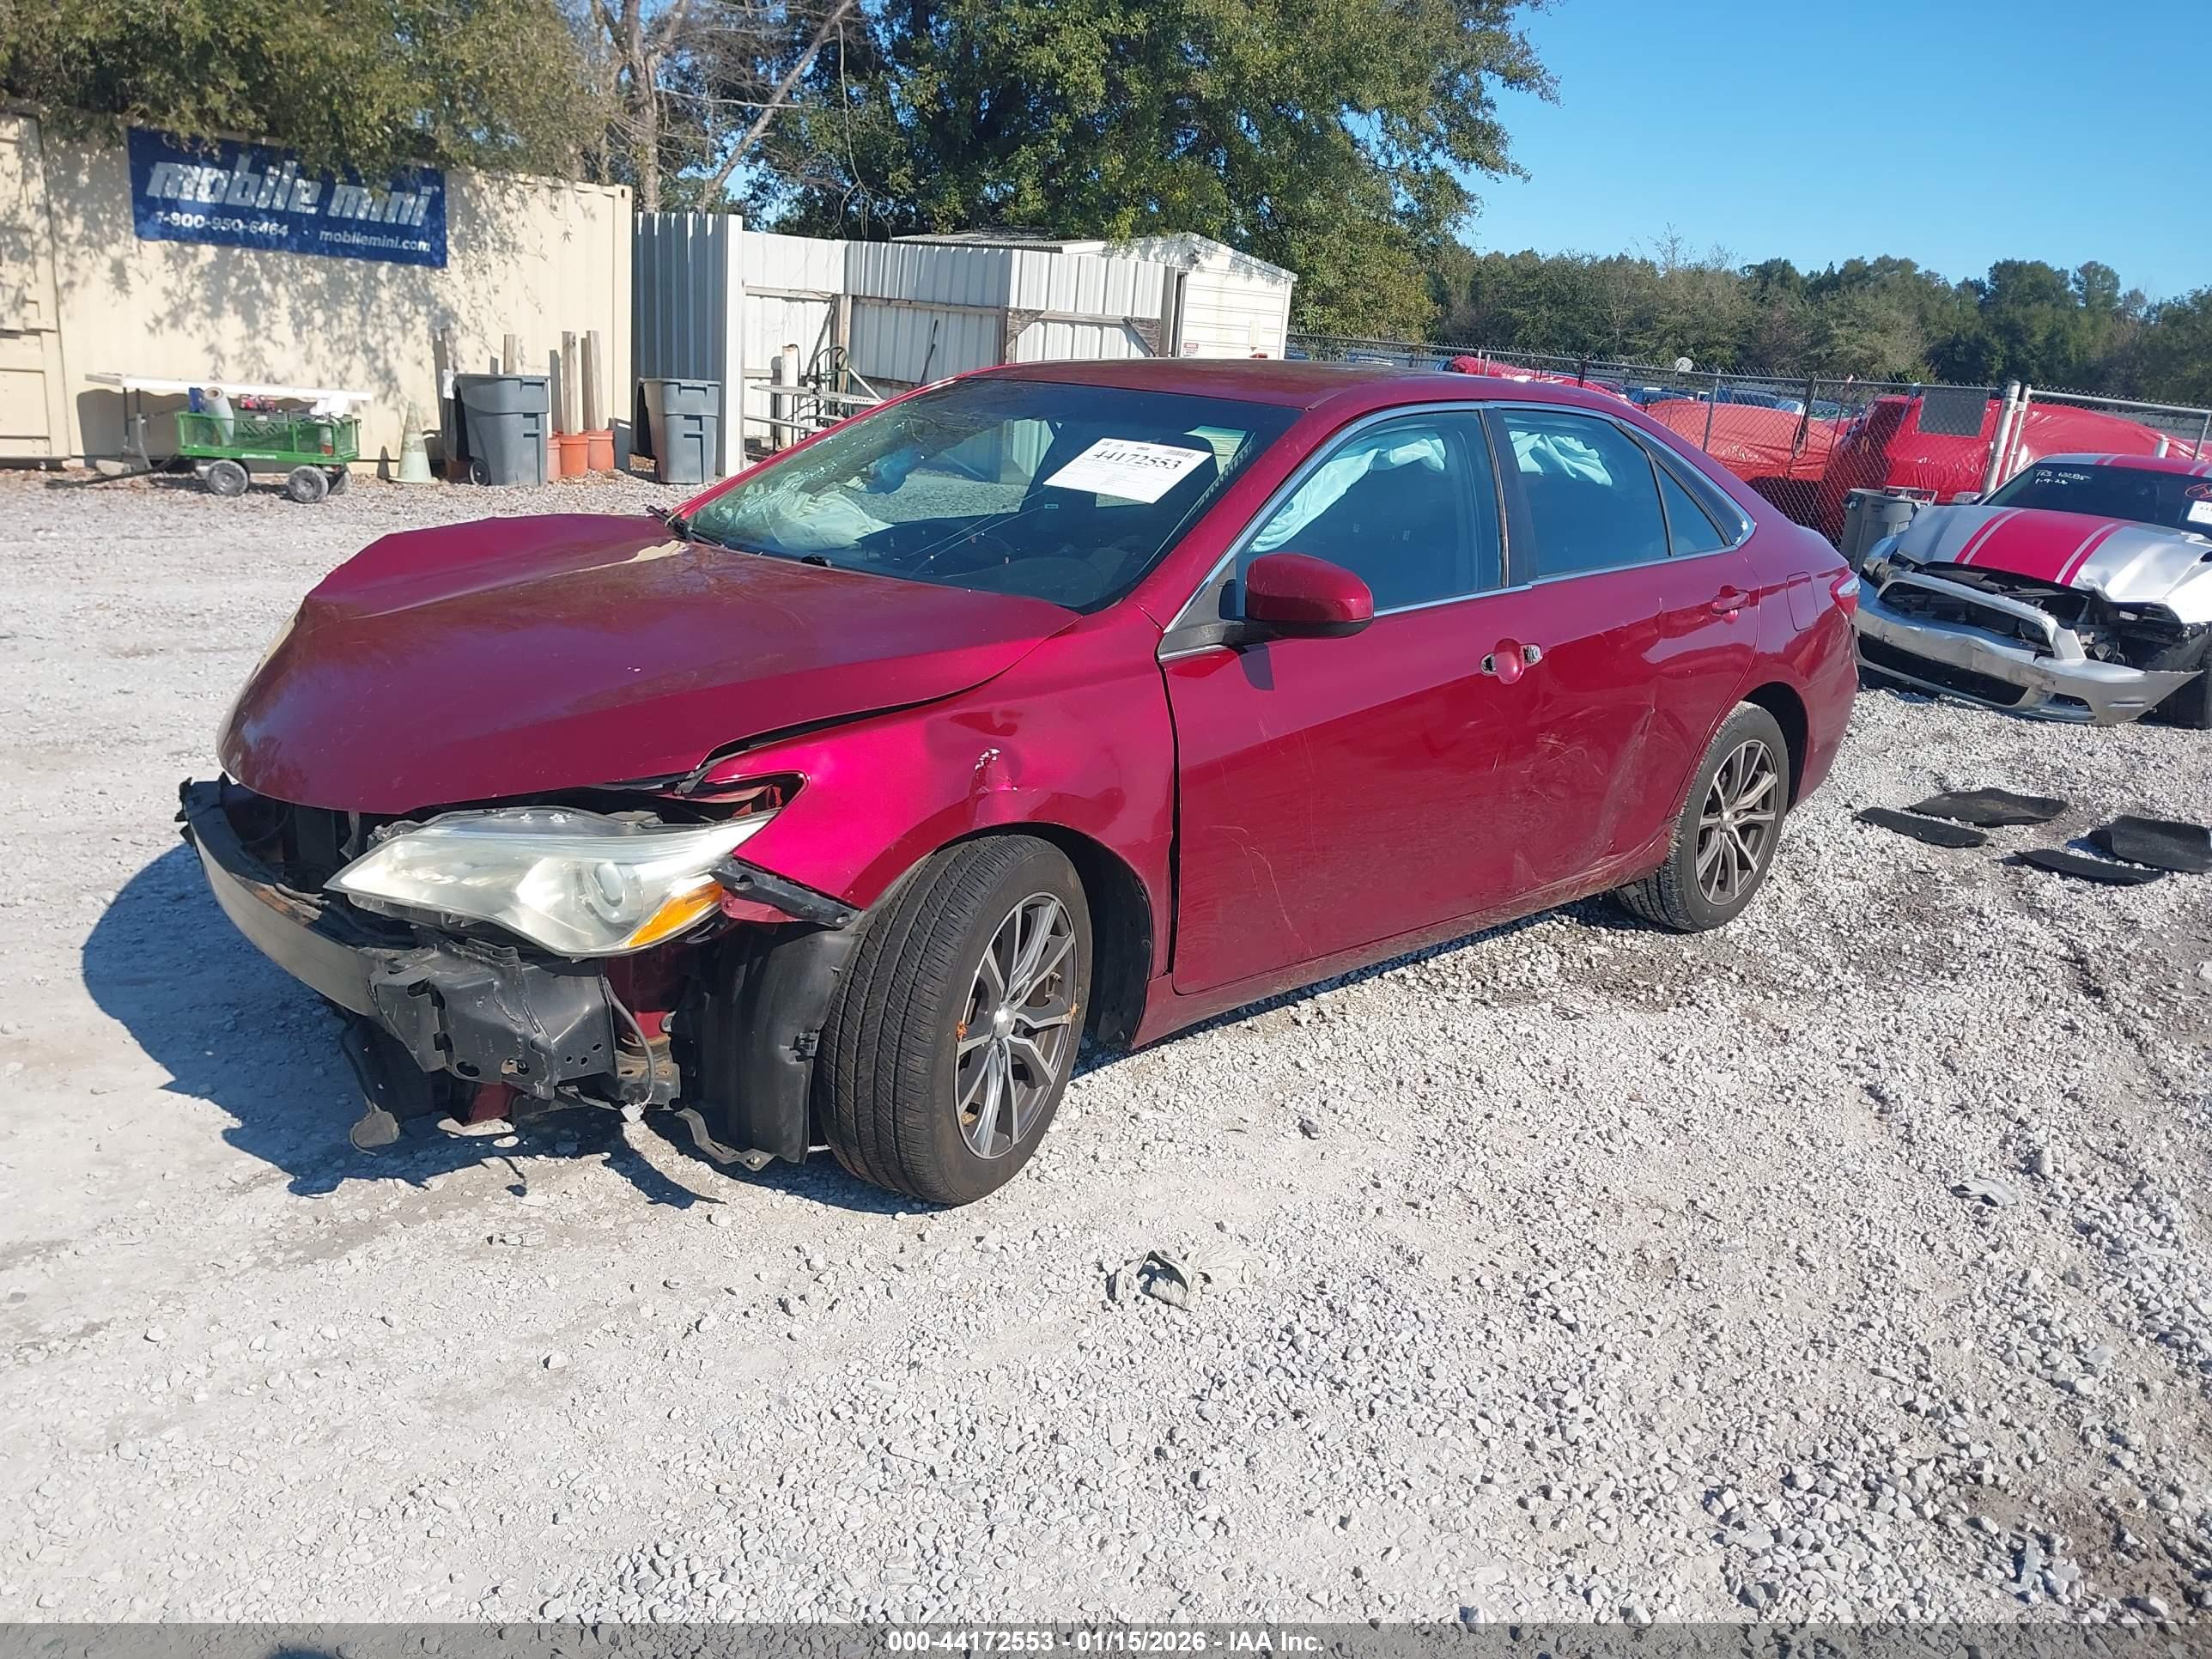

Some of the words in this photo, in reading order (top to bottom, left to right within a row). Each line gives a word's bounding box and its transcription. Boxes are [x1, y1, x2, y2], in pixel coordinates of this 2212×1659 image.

[146, 153, 322, 215] mobile
[327, 179, 433, 228] mini
[319, 230, 431, 252] mobilemini.com
[1093, 450, 1182, 470] 44172553
